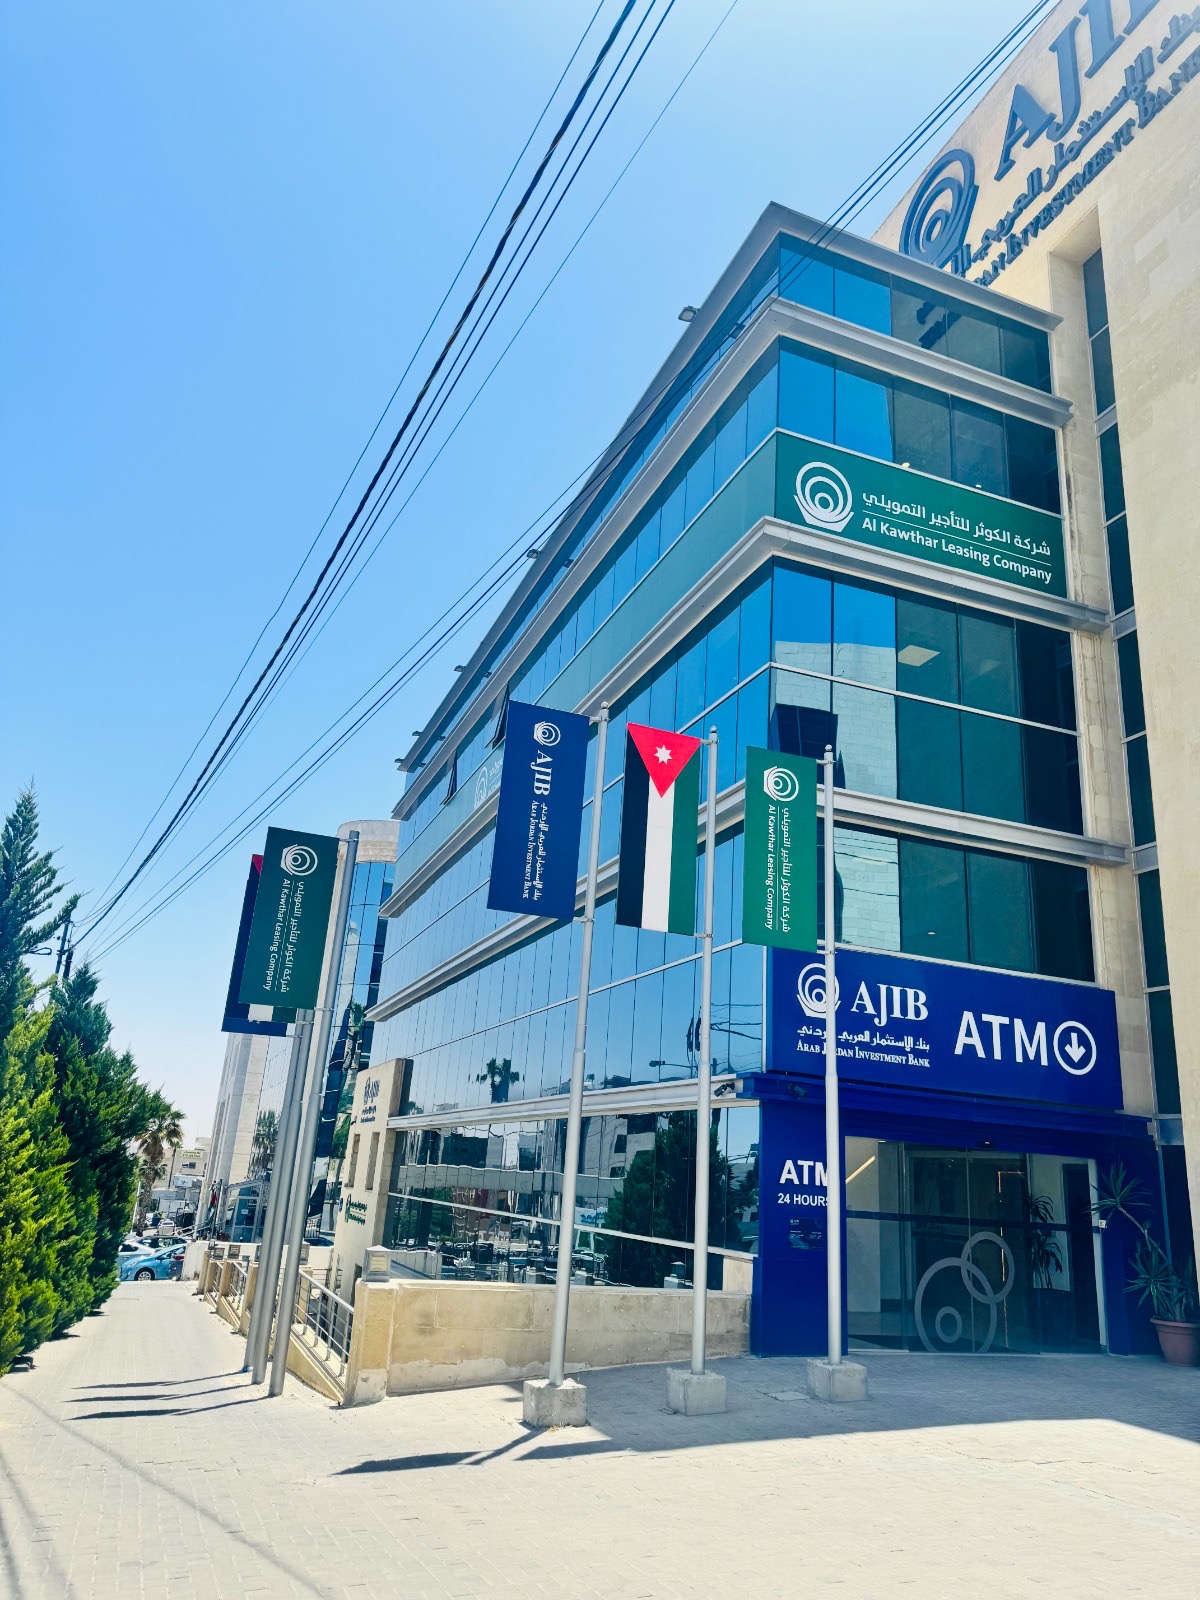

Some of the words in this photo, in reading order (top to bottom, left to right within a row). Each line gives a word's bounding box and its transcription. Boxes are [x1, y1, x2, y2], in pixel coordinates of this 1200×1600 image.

[1004, 117, 1136, 265] INVESTMENT
[862, 492, 926, 519] التمويلي
[928, 510, 970, 532] للتأجير
[973, 522, 1011, 544] الكوثر
[862, 517, 877, 532] Al
[880, 521, 939, 549] Kawthar
[941, 538, 991, 567] Leasing
[993, 554, 1052, 584] Company
[1013, 534, 1051, 556] شركة
[530, 749, 553, 796] AJIB
[530, 799, 540, 817] ARAB
[768, 804, 776, 814] Al
[528, 817, 538, 841] JORDAN
[767, 815, 776, 852] Kawthar
[780, 807, 791, 847] التمويلي
[524, 841, 536, 881] INVESTMENT
[765, 853, 775, 886] Leasing
[780, 847, 793, 876] للتأجير
[282, 878, 290, 887] Al
[522, 881, 532, 899] BANK
[780, 876, 791, 904] الكوثر
[277, 888, 289, 921] Kawthar
[293, 881, 305, 917] التمويلي
[764, 888, 774, 930] Company
[289, 917, 301, 942] للتأجير
[780, 905, 791, 932] شركة
[269, 922, 283, 952] Leasing
[284, 942, 297, 967] الكوثر
[262, 953, 278, 991] Company
[280, 968, 292, 993] شركة
[850, 980, 929, 1027] AJIB
[837, 1030, 871, 1043] العربي
[914, 1037, 930, 1053] بنك
[954, 1010, 1048, 1067] ATM
[796, 1039, 820, 1053] ARAB
[822, 1042, 854, 1058] JDAN
[855, 1046, 906, 1064] INVESTMENT
[907, 1053, 930, 1068] BANK
[777, 1192, 791, 1205] 24
[793, 1193, 828, 1207] HOUR
